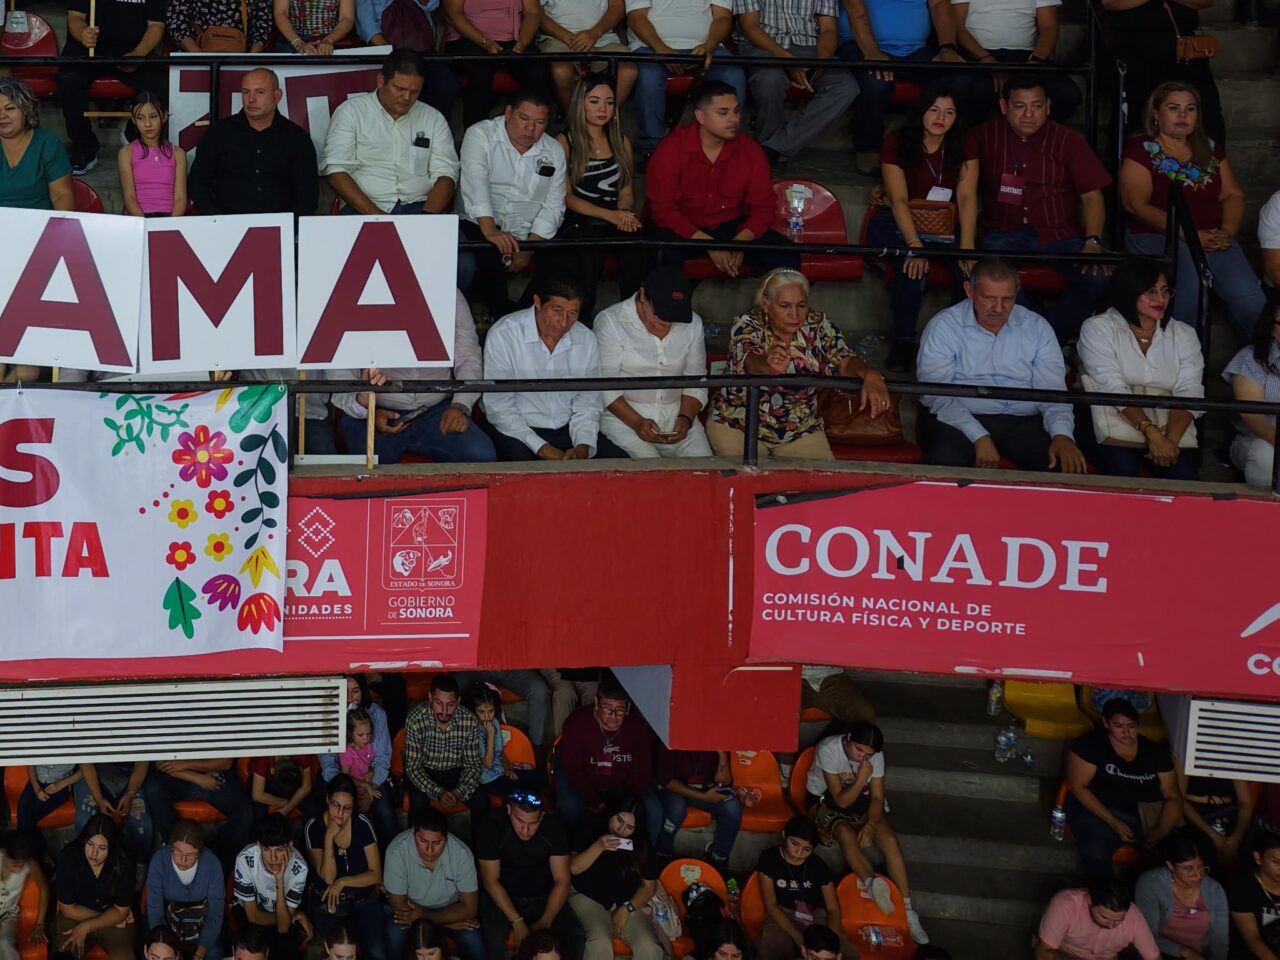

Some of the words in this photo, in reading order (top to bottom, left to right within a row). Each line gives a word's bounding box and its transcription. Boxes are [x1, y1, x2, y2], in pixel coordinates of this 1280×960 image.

[765, 523, 1110, 593] CONADE
[387, 611, 398, 619] DE
[399, 607, 454, 619] SONORA
[388, 595, 456, 608] GOBIERNO
[762, 592, 855, 608] COMISIÓN
[861, 596, 960, 615] NACIONAL
[966, 603, 992, 617] DE
[761, 608, 845, 624] CULTURA
[851, 610, 913, 628] FÍSICA
[919, 617, 931, 629] Y
[936, 617, 1027, 636] DEPORTE
